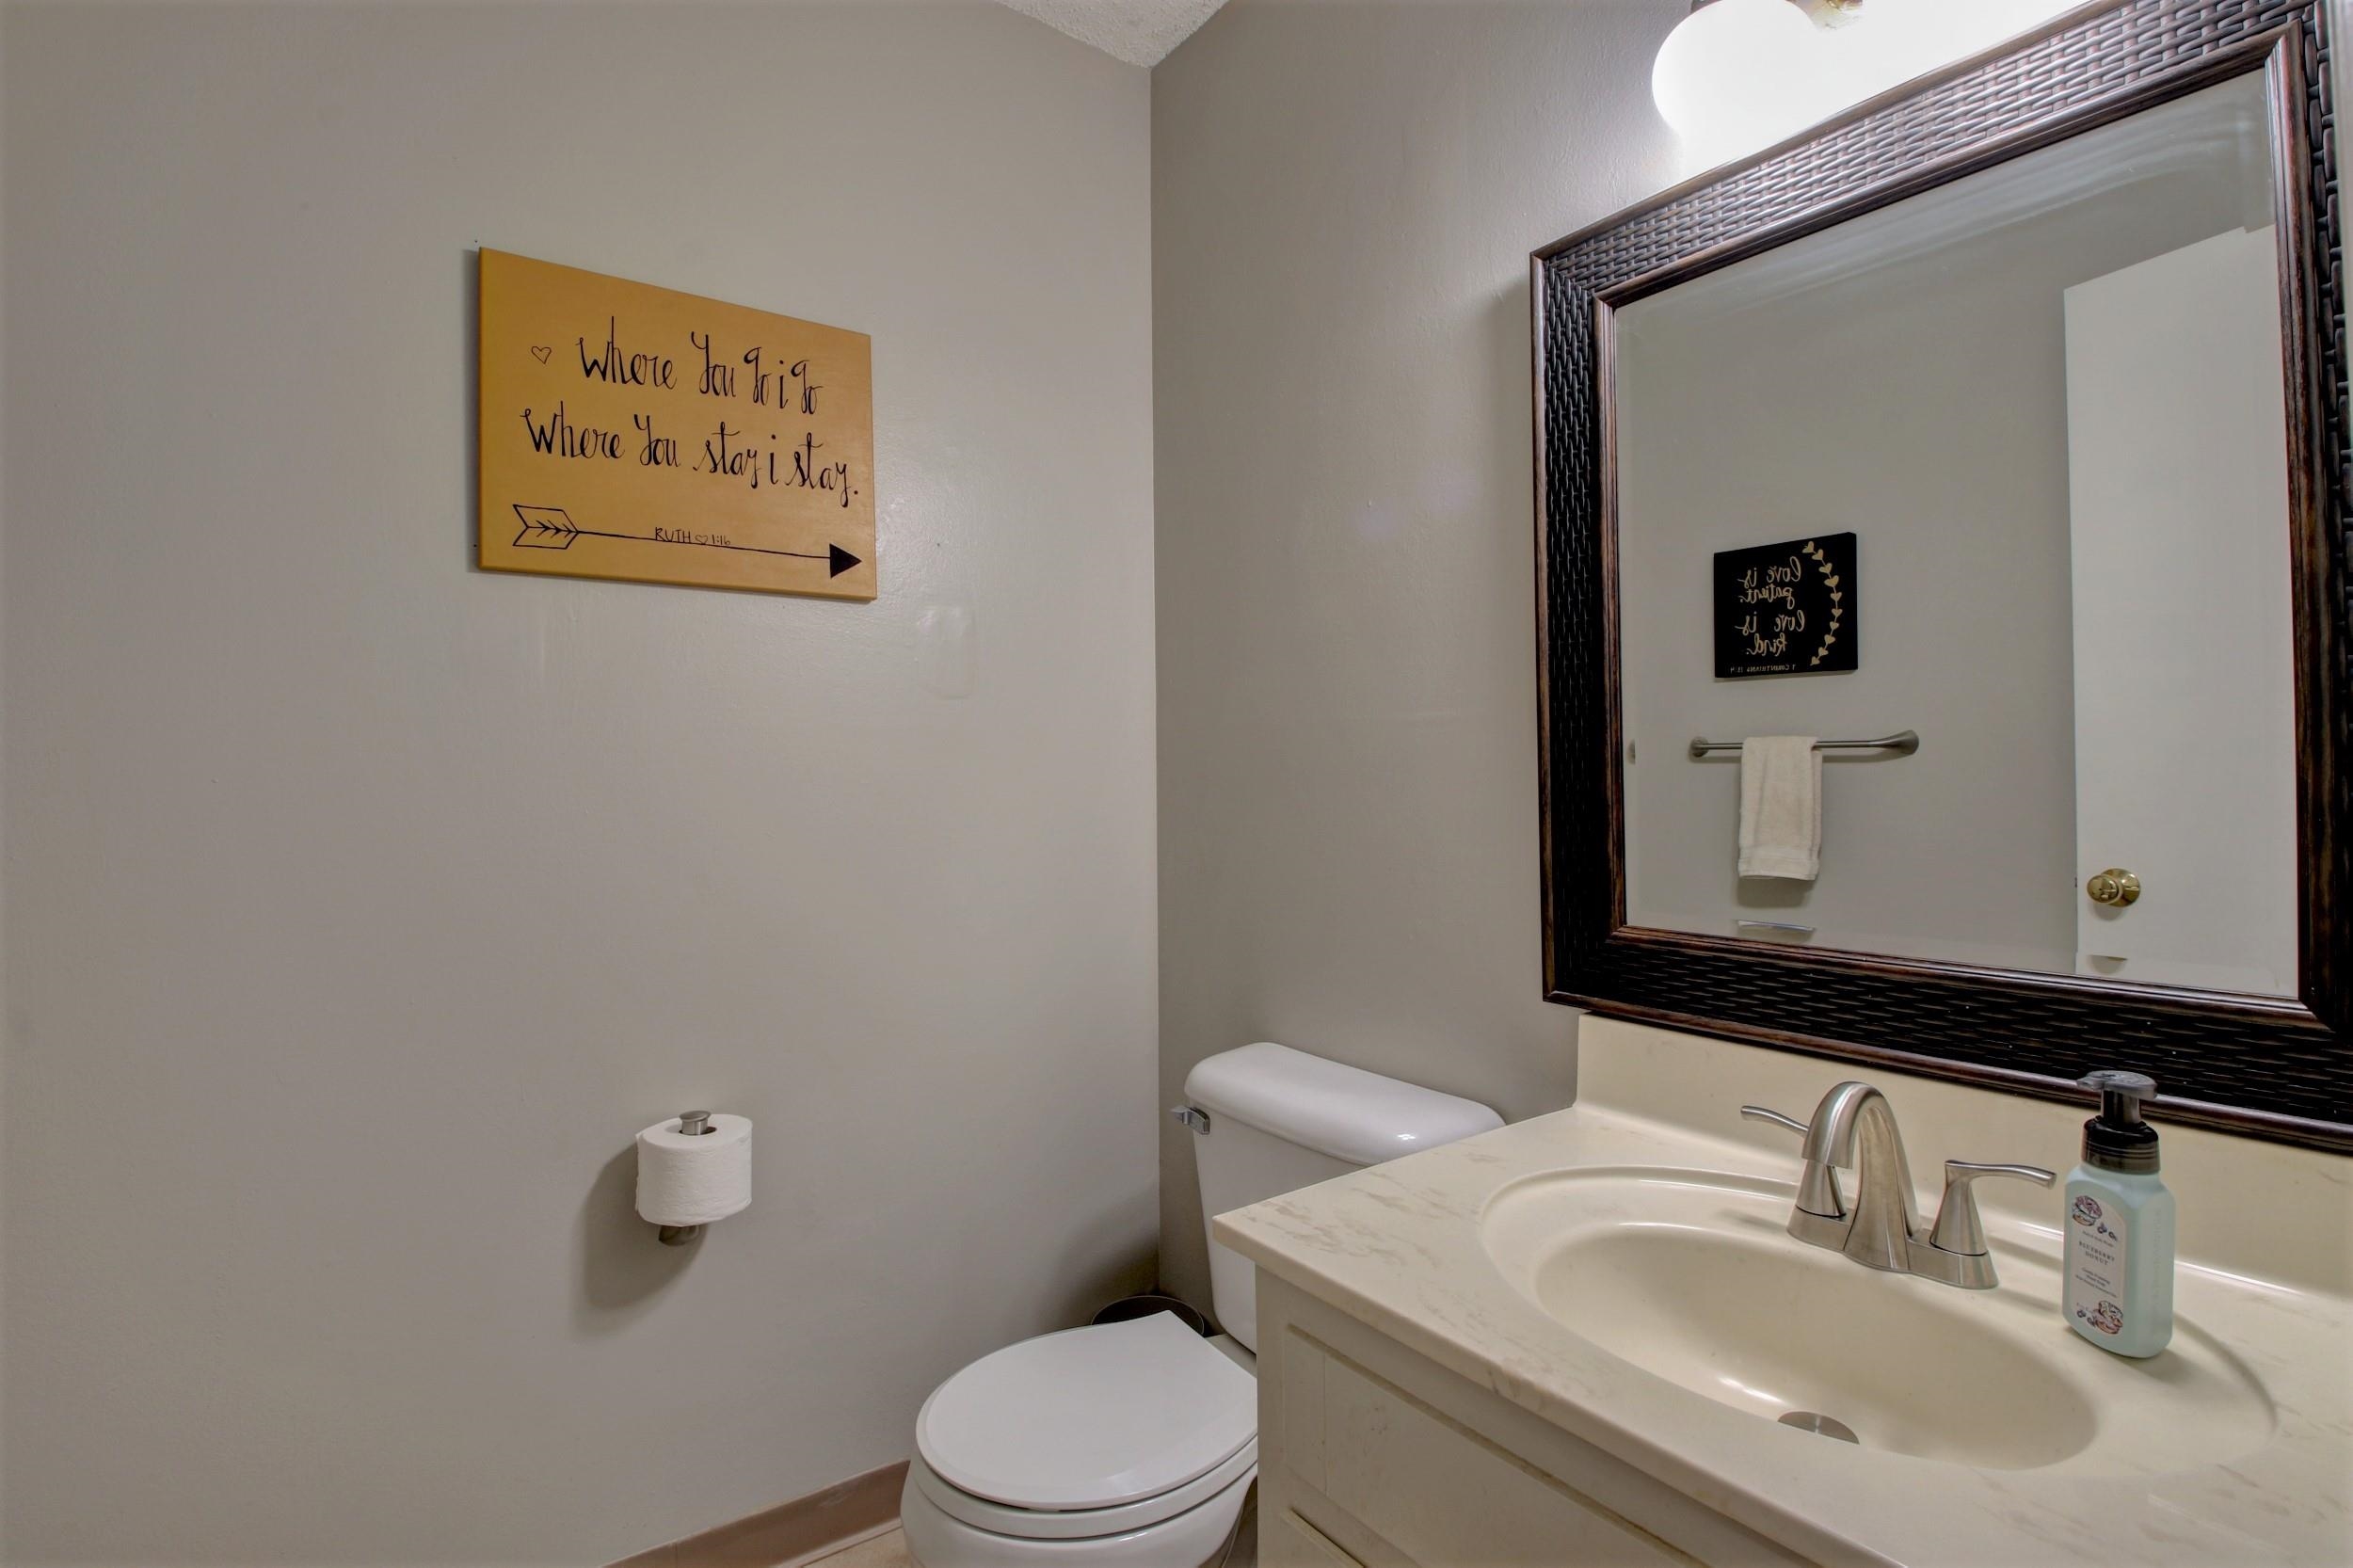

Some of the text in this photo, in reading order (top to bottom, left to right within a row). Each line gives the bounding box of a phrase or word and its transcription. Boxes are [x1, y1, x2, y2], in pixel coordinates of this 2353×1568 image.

[691, 331, 737, 397] You
[778, 360, 789, 408] i
[520, 401, 858, 507] Where You stay i stay.
[655, 527, 730, 545] RUTH 1:16
